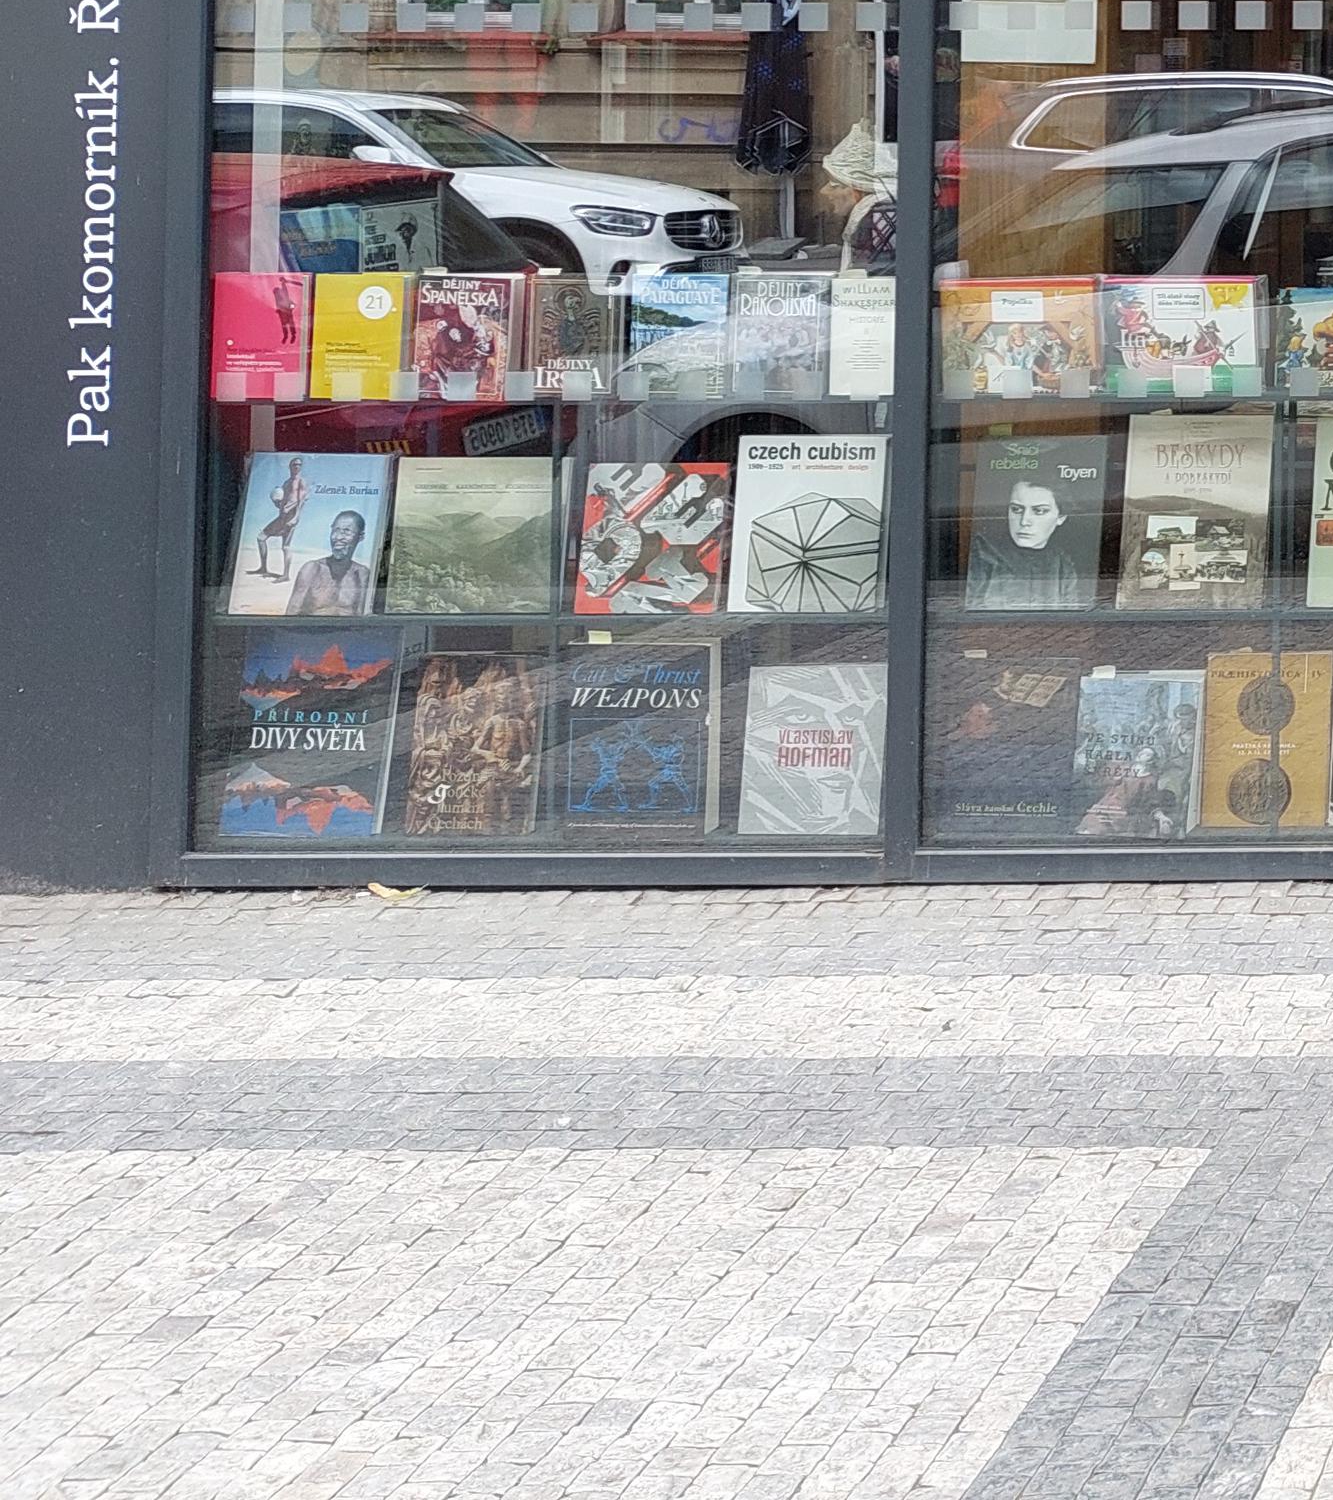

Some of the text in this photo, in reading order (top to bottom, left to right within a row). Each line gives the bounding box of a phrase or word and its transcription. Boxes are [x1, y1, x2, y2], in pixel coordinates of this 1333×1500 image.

[71, 56, 120, 338] komorník.
[442, 279, 481, 290] DĚJINY
[757, 281, 802, 297] DĚJINY
[842, 285, 891, 295] WILLIAM
[365, 295, 384, 310] 21
[421, 283, 500, 307] ŠPANĚLSKA
[740, 294, 817, 317] RAKOUSKA
[547, 358, 593, 370] DĚJINY
[67, 346, 110, 447] Pak
[748, 442, 876, 460] czech cubism
[1156, 444, 1247, 469] BESKYDY
[990, 457, 1039, 470] rebelka
[1057, 464, 1097, 482] Toyen
[1175, 472, 1231, 485] POBESKYDÍ
[314, 484, 379, 495] Zdeněk Burian
[642, 662, 702, 684] Thrust
[570, 688, 703, 709] WEAPONS
[253, 708, 369, 722] PŘÍRODNÍ
[249, 722, 366, 751] DIVY SVĚTA
[955, 802, 982, 813] Sláva
